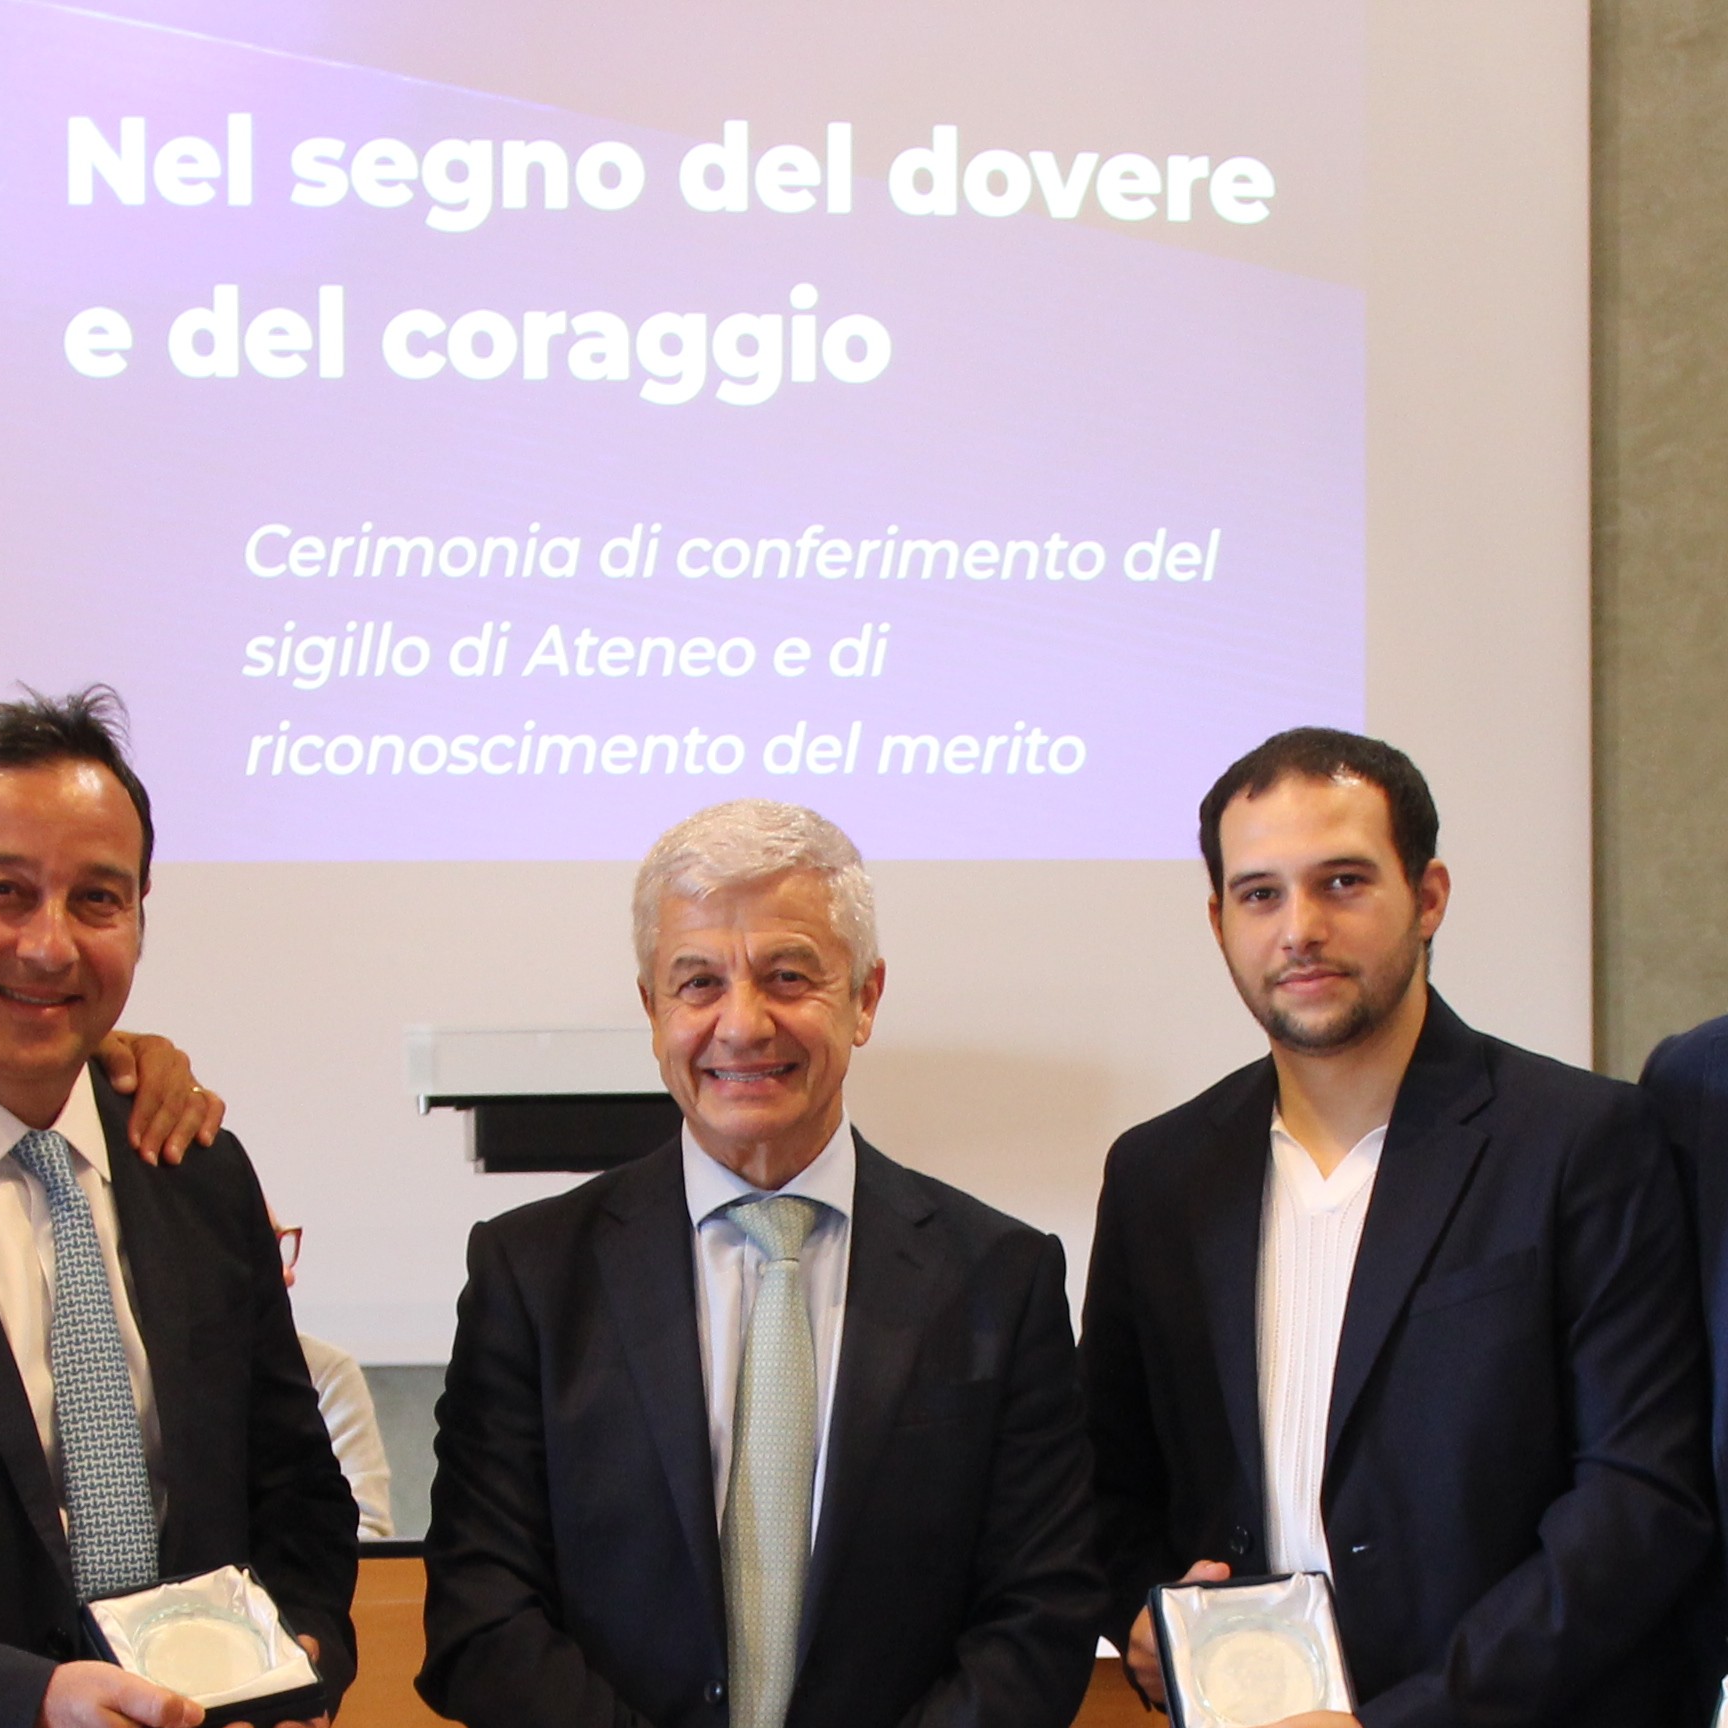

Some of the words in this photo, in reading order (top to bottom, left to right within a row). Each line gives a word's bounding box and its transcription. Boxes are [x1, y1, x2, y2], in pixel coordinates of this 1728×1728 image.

[67, 113, 254, 206] Nel
[290, 136, 646, 233] segno
[679, 120, 853, 214] del
[888, 125, 1276, 225] dovere
[64, 307, 133, 379] e
[168, 284, 345, 380] del
[382, 283, 893, 407] coraggio
[244, 522, 582, 579] Cerimonia
[599, 522, 663, 579] di
[676, 524, 1106, 582] conferimento
[1122, 527, 1222, 583] del
[242, 621, 431, 691] sigillo
[448, 621, 514, 678] di
[522, 624, 757, 678] Ateneo
[773, 636, 812, 678] e
[828, 622, 891, 678] di
[245, 719, 747, 777] riconoscimento
[763, 720, 863, 776] del
[877, 720, 1087, 777] merito
